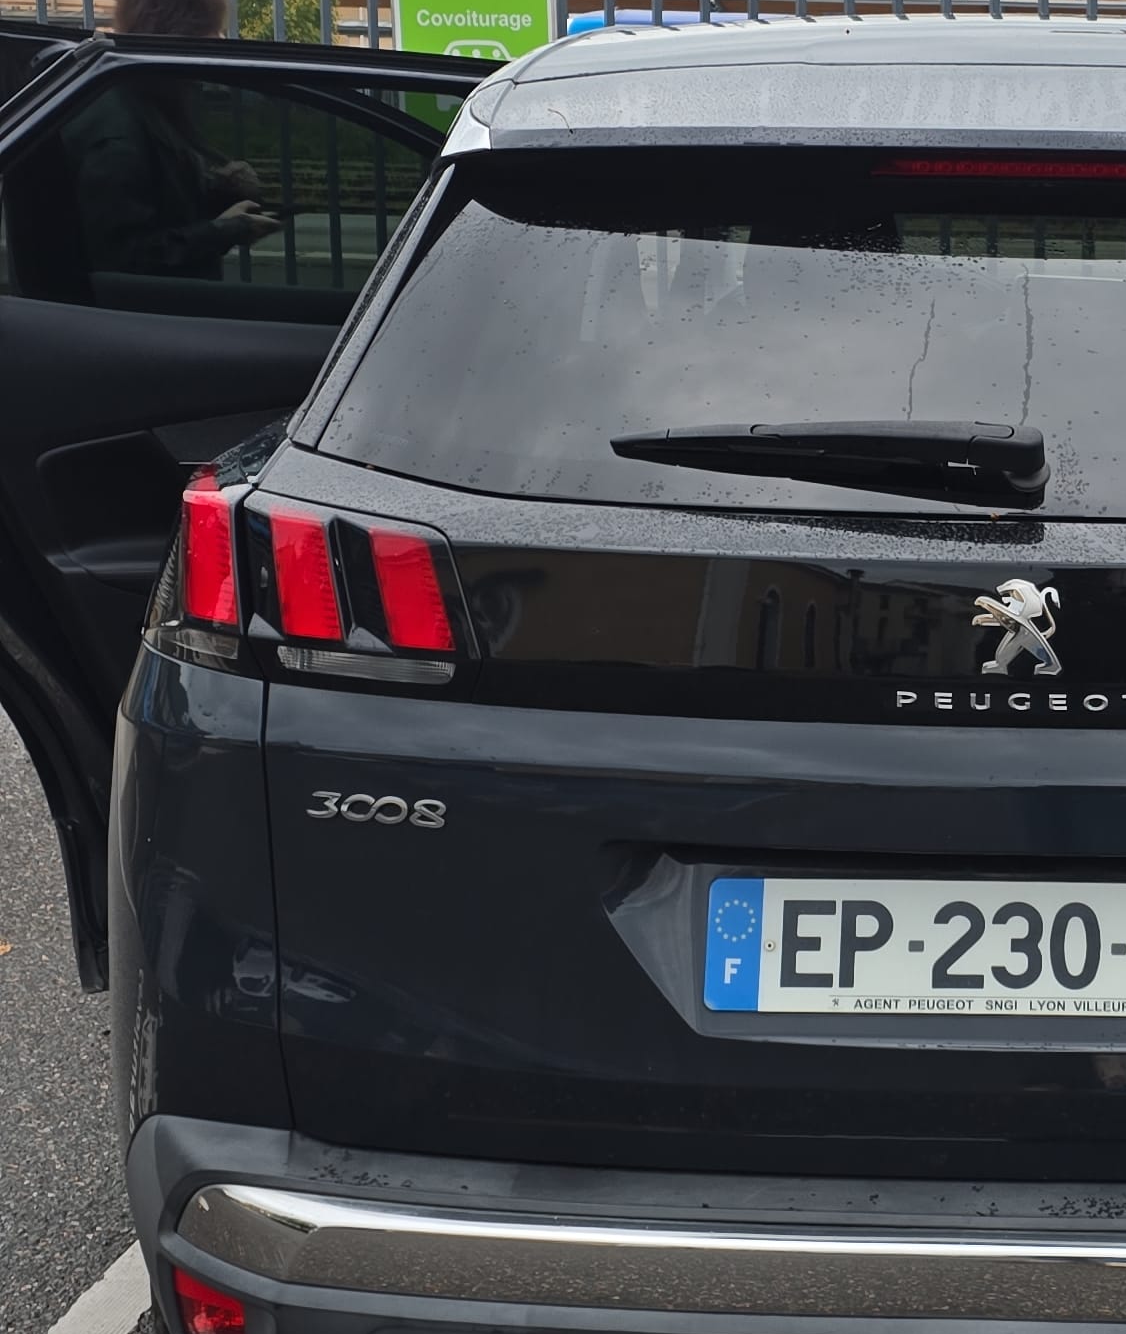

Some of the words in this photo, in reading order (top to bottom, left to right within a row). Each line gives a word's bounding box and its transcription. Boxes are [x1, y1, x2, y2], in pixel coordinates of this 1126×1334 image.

[416, 9, 533, 31] Covoiturage
[305, 790, 447, 829] 3008
[723, 957, 742, 985] F
[853, 998, 901, 1010] AGENT
[908, 999, 974, 1011] PEUGEOT
[985, 1000, 1018, 1011] SNGI
[1029, 1000, 1066, 1012] LYON
